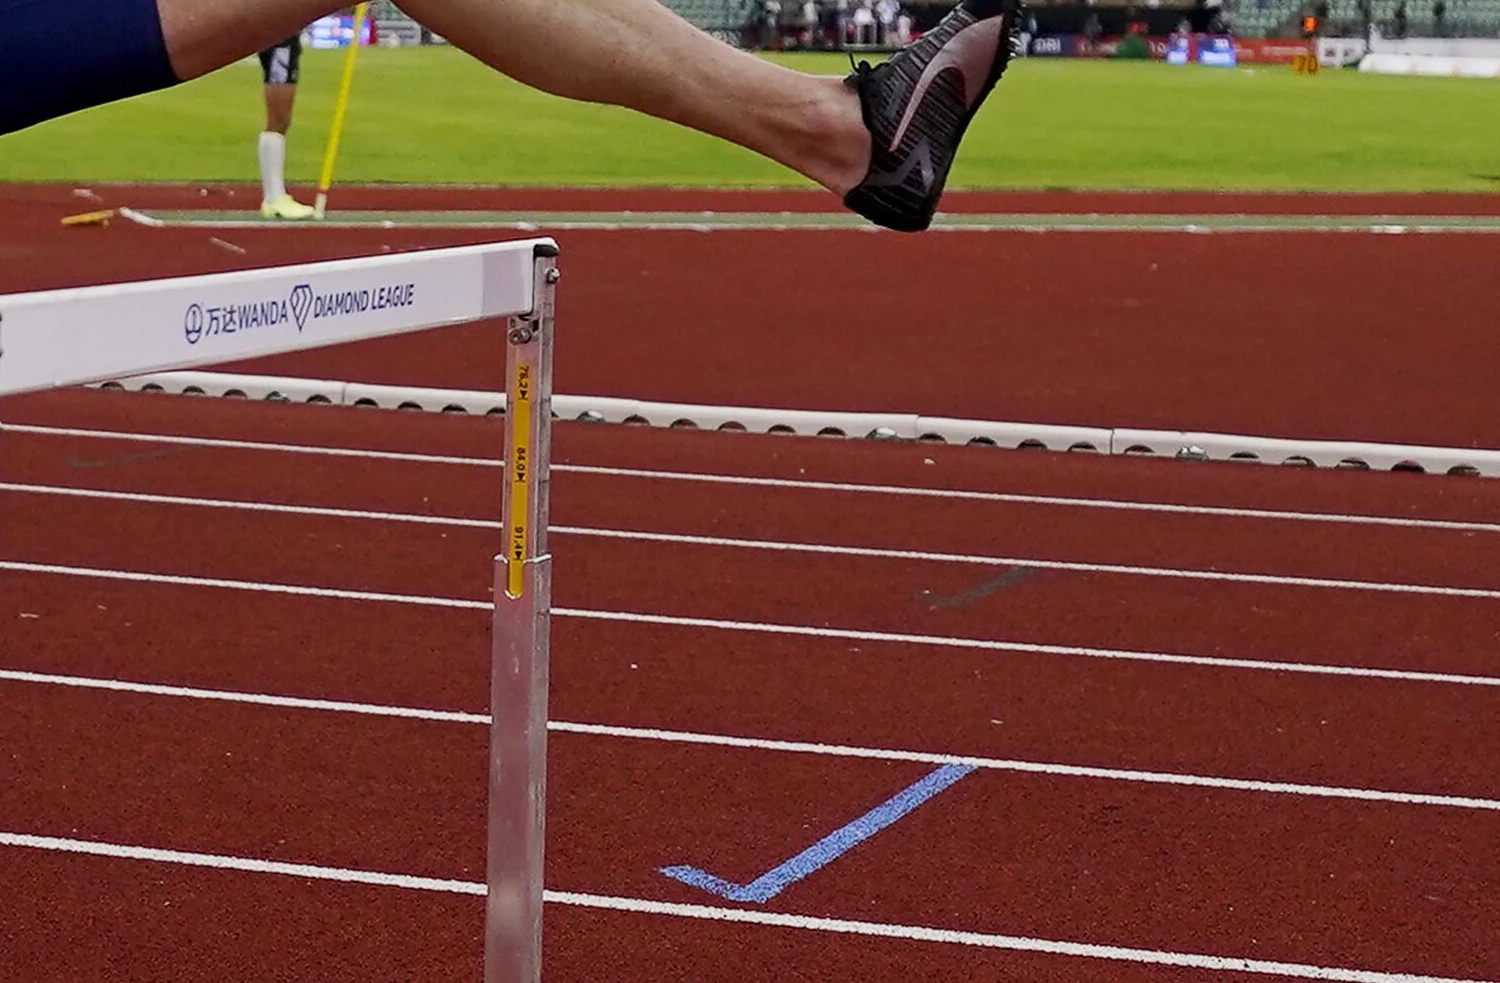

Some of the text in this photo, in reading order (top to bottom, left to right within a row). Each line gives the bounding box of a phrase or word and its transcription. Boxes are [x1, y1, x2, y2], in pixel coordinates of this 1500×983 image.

[205, 283, 415, 336] 万达 WANDA DIAMOND LEAGUE
